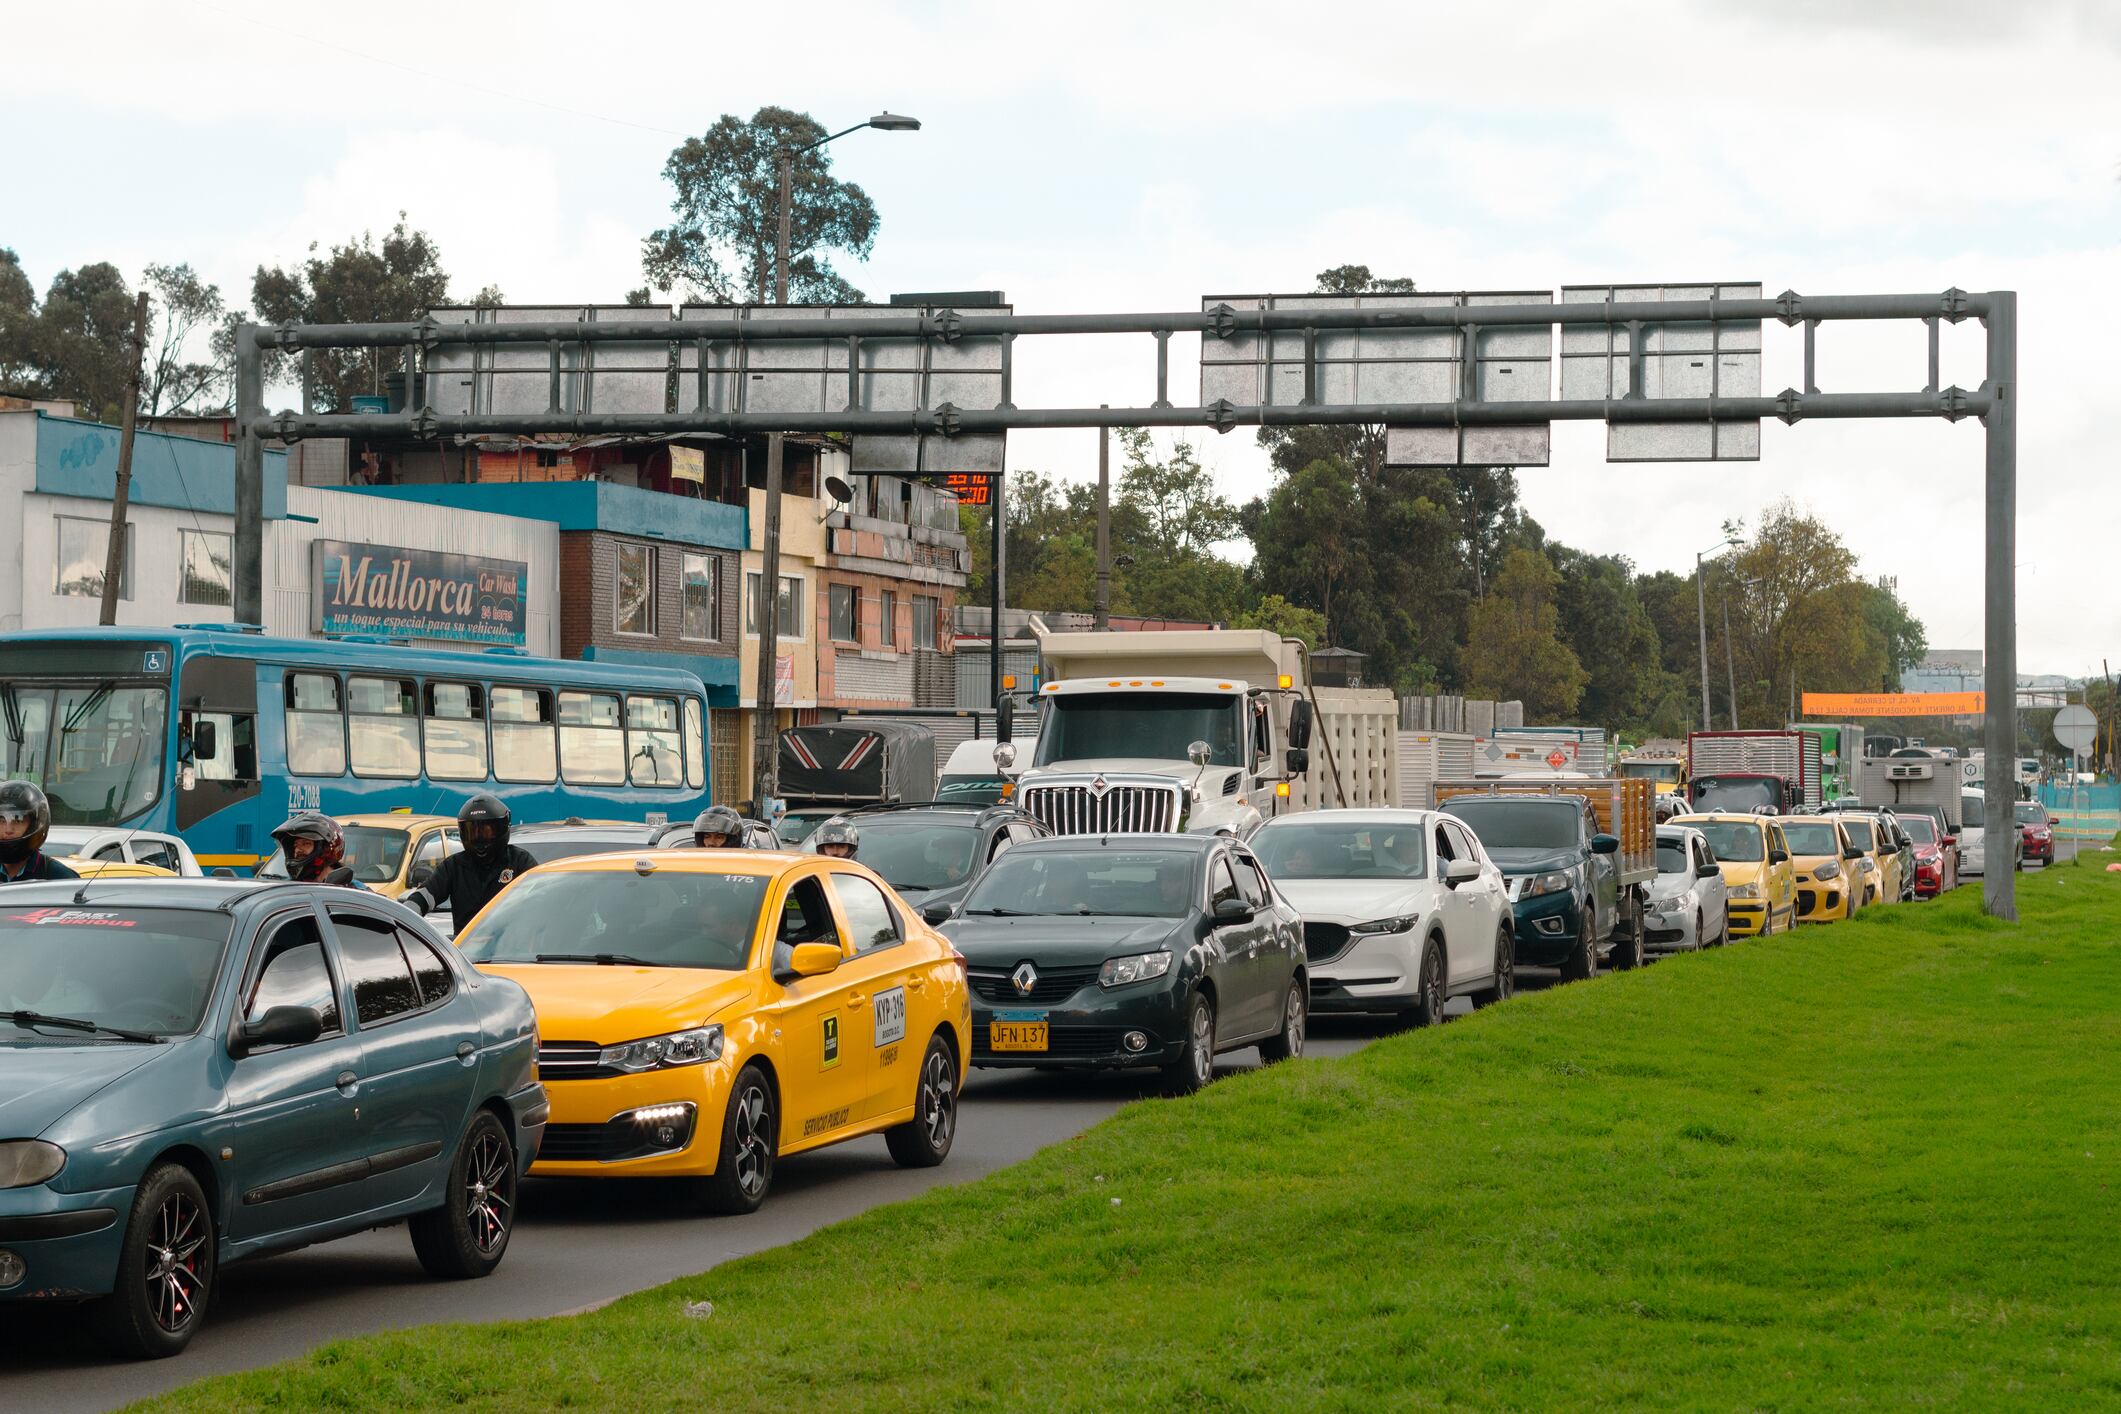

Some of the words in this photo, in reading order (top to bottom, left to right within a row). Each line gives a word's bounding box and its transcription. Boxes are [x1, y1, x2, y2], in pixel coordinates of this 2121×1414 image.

[331, 555, 474, 616] Mallorca
[480, 573, 495, 593] Car
[496, 575, 517, 595] Wash
[333, 613, 349, 624] un
[351, 613, 381, 629] toque
[383, 615, 426, 632] especial
[426, 619, 451, 633] para
[453, 622, 465, 632] su
[287, 785, 321, 808] Z20-7088
[992, 1027, 1018, 1043] JFN
[1021, 1027, 1046, 1043] 137
